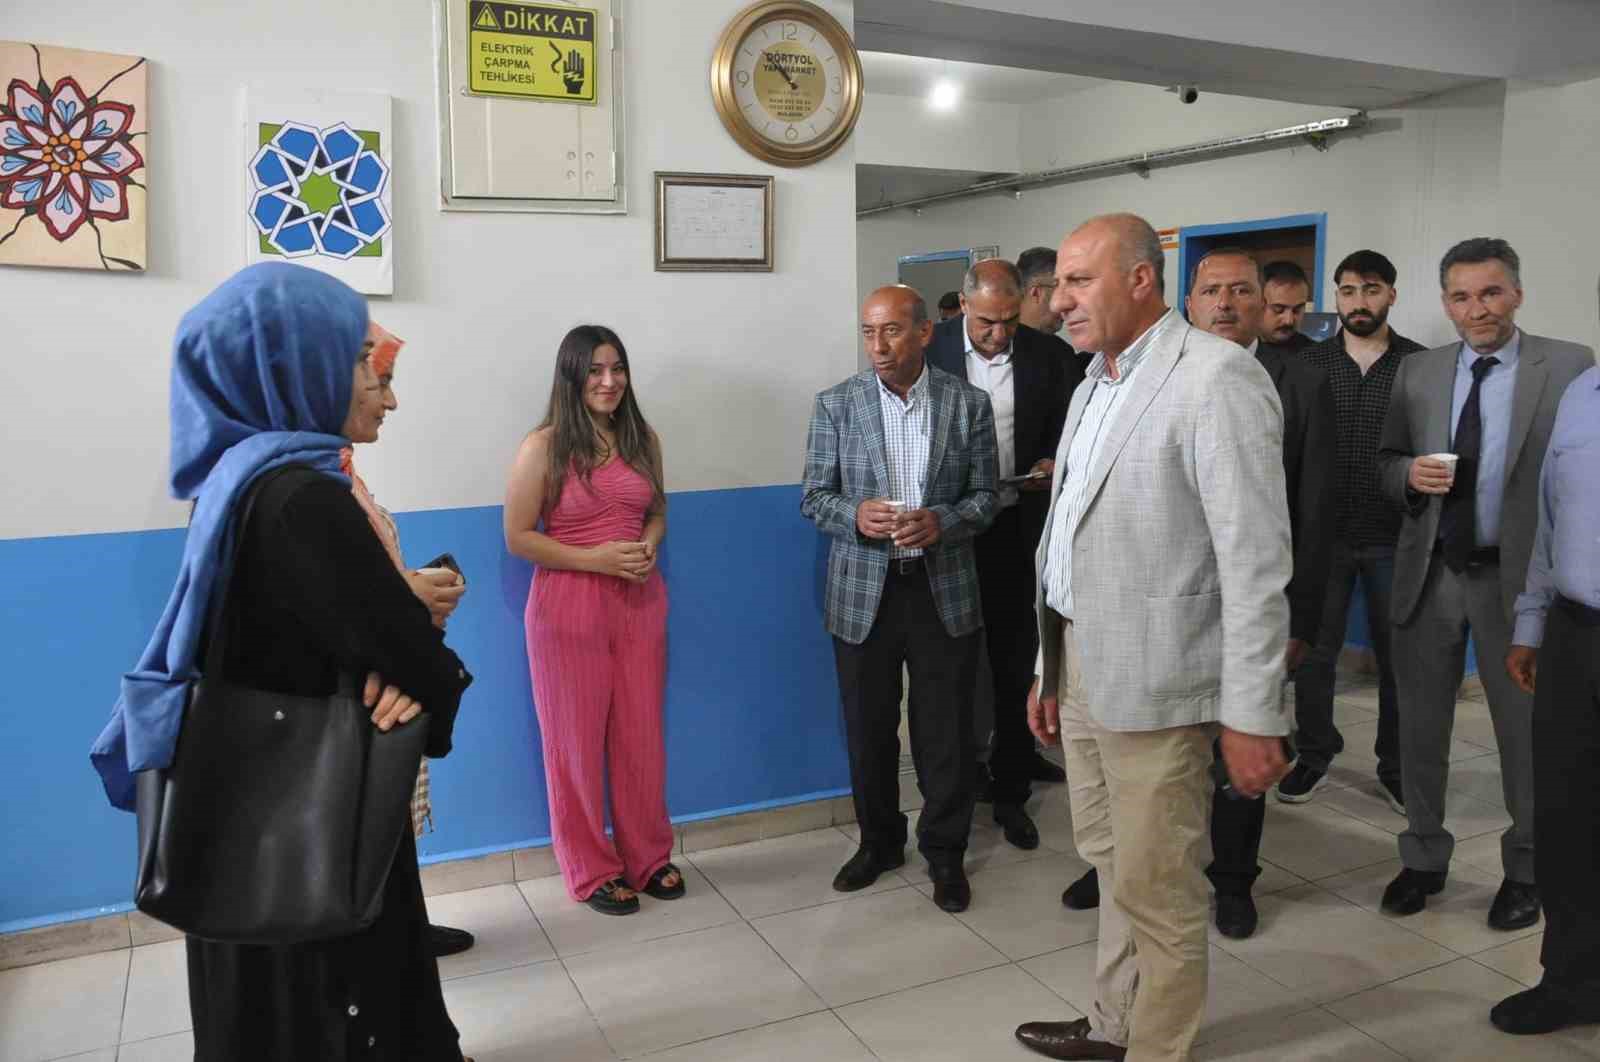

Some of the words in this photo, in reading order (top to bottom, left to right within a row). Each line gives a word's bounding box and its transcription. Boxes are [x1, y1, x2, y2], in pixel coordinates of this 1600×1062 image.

[504, 8, 588, 35] DİKKAT
[782, 22, 798, 41] 12
[480, 42, 534, 56] ELEKTRİK
[484, 57, 530, 70] ÇARPMA
[480, 71, 536, 85] TEHLİKESİ
[785, 123, 799, 140] 6
